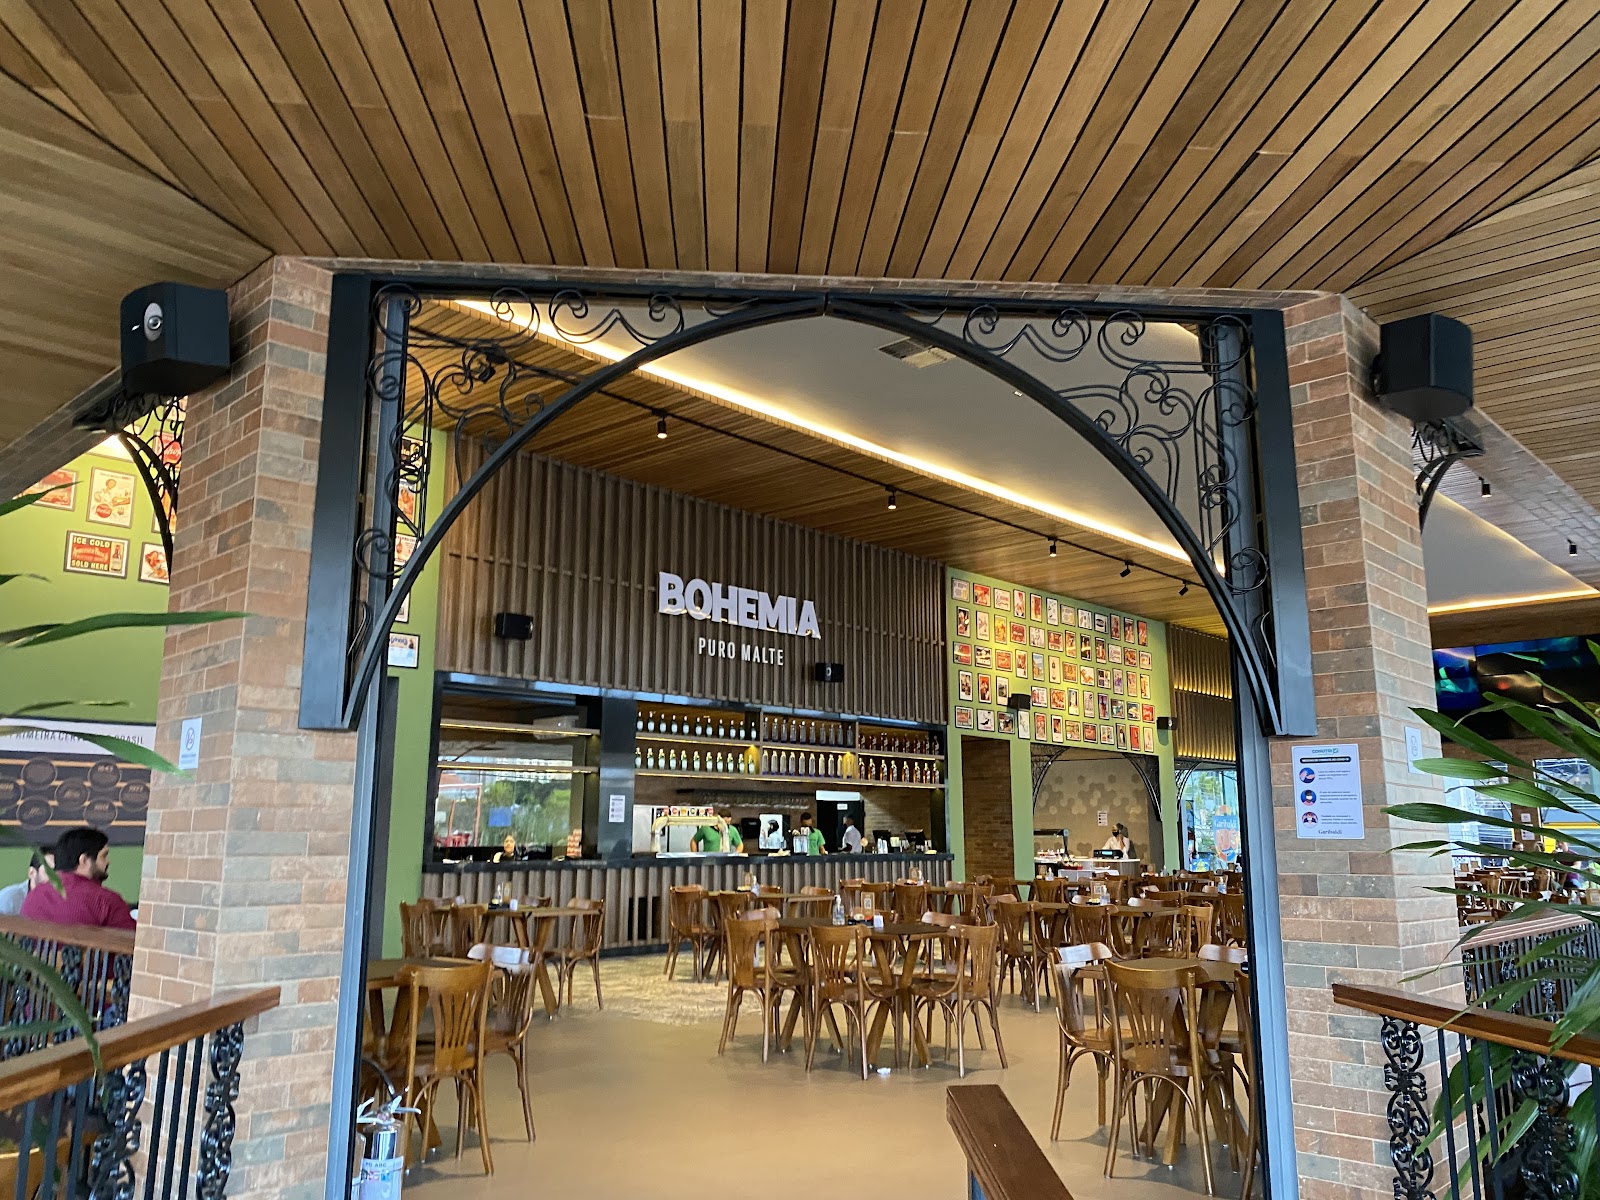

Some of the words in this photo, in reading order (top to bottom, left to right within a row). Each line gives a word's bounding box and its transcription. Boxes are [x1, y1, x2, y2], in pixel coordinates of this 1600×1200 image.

[73, 536, 87, 545] ICE
[89, 539, 110, 548] COLD
[71, 560, 89, 568] SOLD
[90, 562, 109, 570] HERE
[658, 571, 821, 640] BOHEMIA
[698, 637, 736, 660] PURO
[741, 643, 784, 666] MALTE
